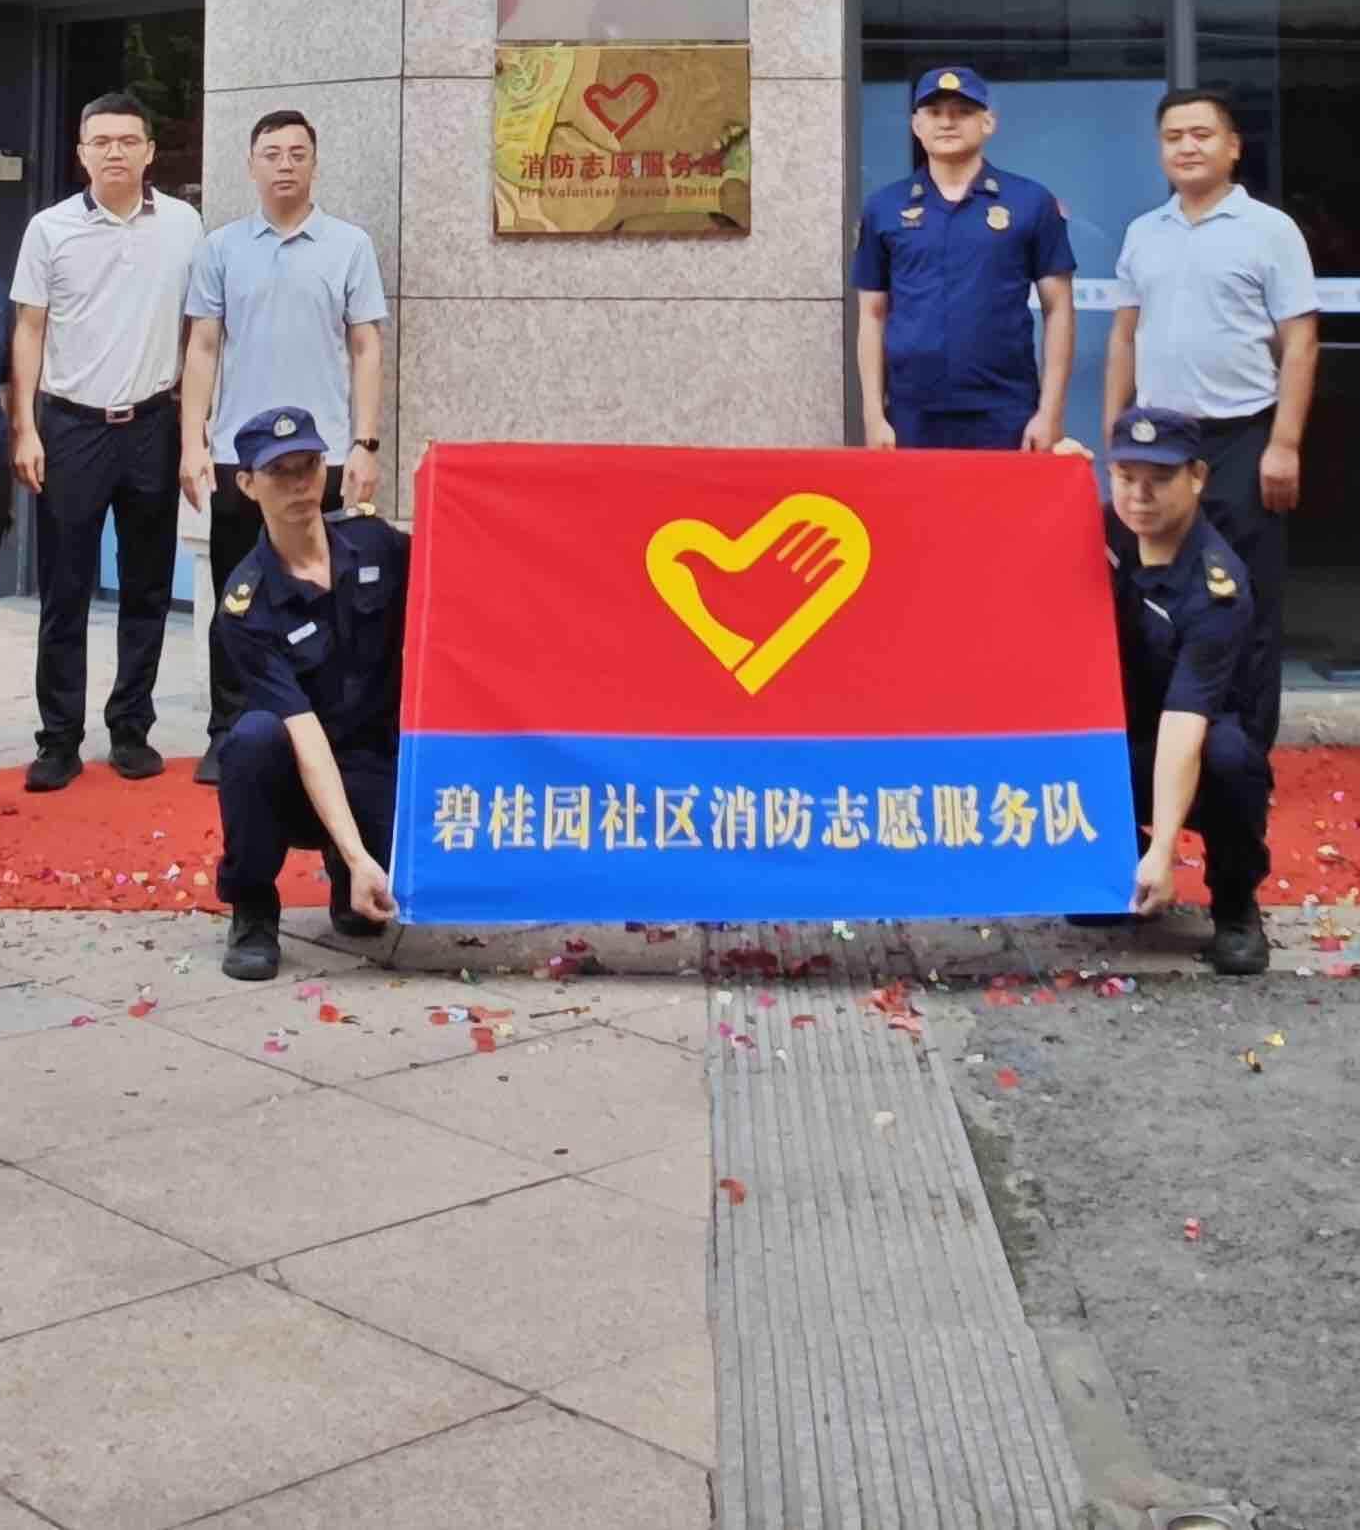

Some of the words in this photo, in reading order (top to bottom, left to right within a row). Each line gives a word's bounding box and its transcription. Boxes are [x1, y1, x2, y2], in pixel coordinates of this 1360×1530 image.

[432, 779, 1099, 854] 碧桂园社区消防志愿服务队
